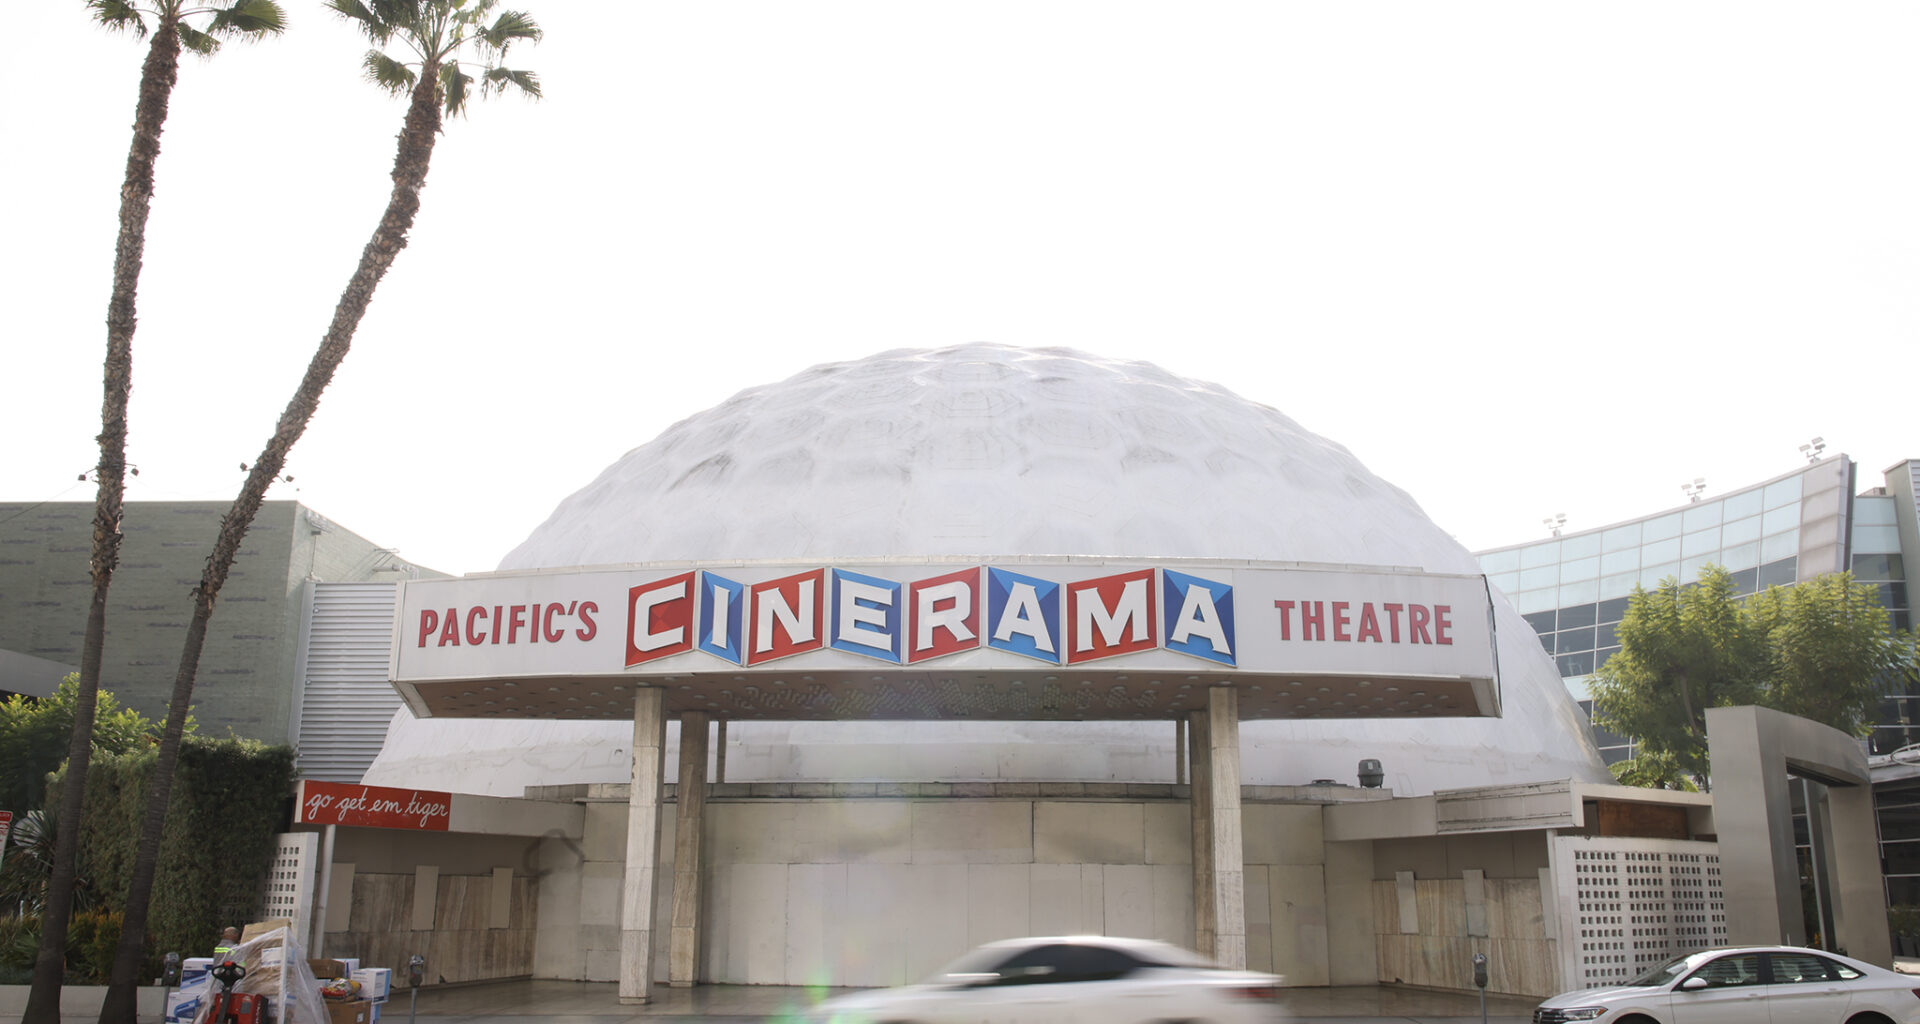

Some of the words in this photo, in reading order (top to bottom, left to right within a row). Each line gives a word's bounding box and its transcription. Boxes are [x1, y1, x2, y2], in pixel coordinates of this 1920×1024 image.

[418, 600, 599, 648] PACIFIC'S
[633, 577, 1233, 657] CINERAMA
[1274, 600, 1453, 646] THEATRE
[305, 793, 334, 821] go
[335, 787, 368, 822] get
[367, 799, 403, 814] em
[403, 791, 448, 828] tiger
